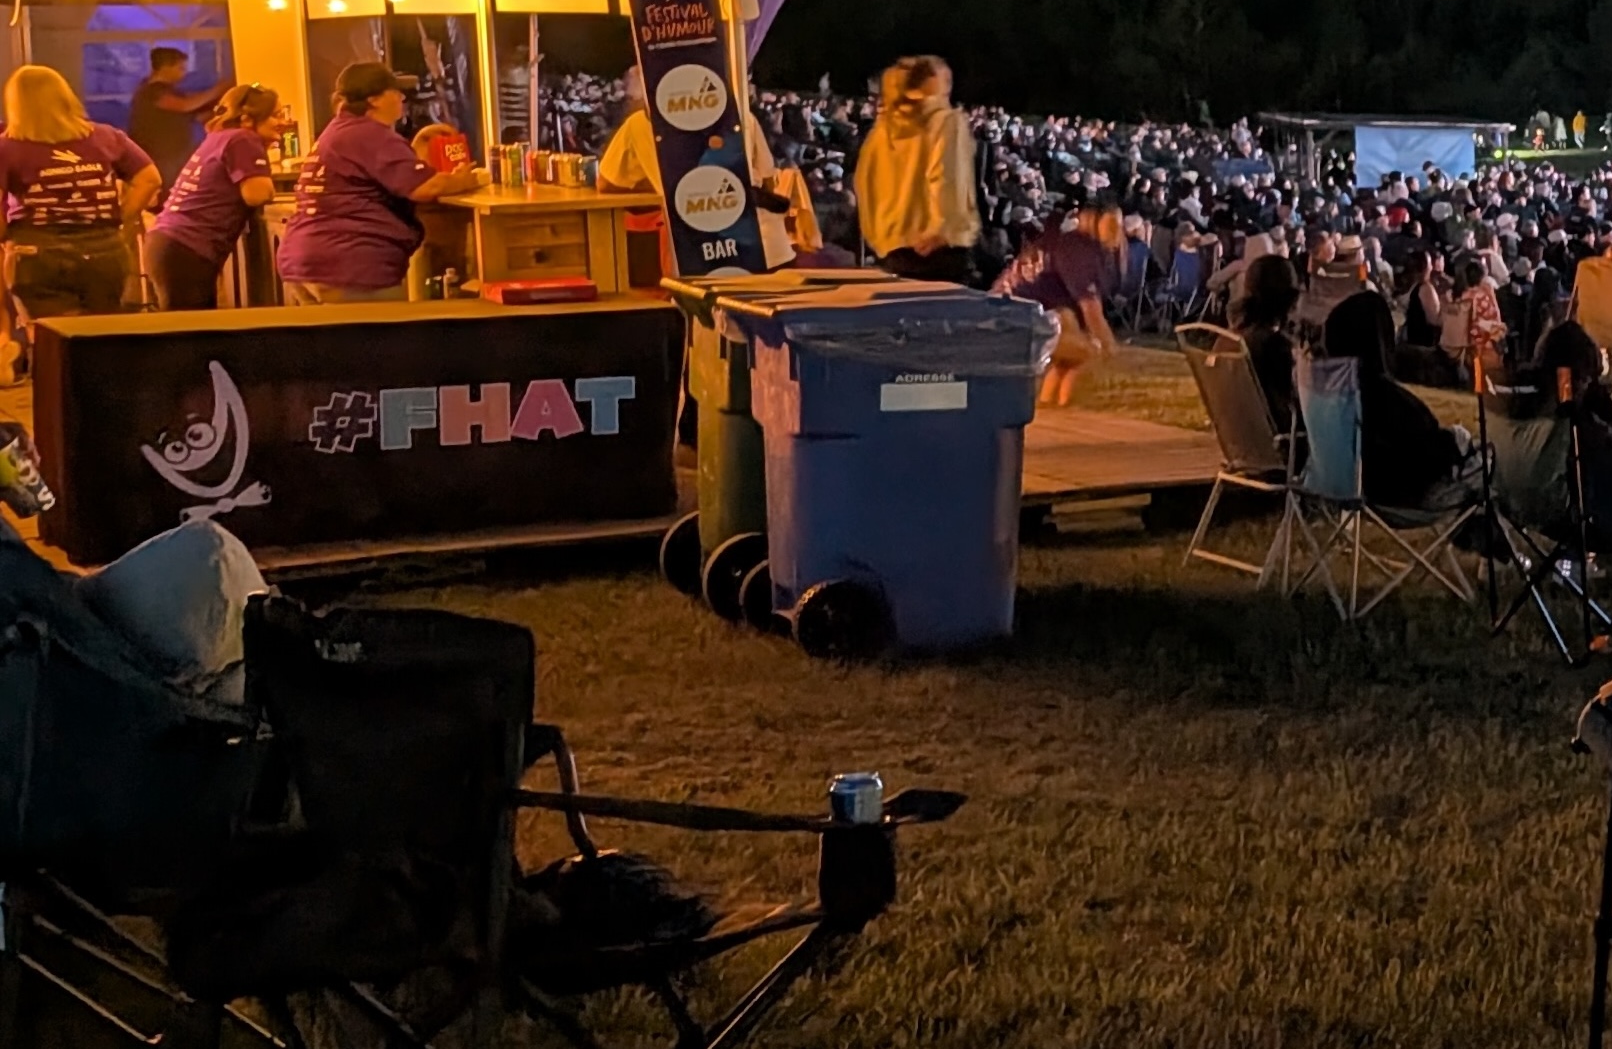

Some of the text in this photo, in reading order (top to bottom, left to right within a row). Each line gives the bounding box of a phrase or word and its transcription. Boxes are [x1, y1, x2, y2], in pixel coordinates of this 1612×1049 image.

[645, 3, 708, 24] FESTIVAL
[641, 17, 715, 42] D'HUMOUR
[667, 92, 719, 114] MNG
[685, 194, 739, 216] MNG
[702, 238, 738, 261] BAR
[309, 376, 636, 454] #FHAT
